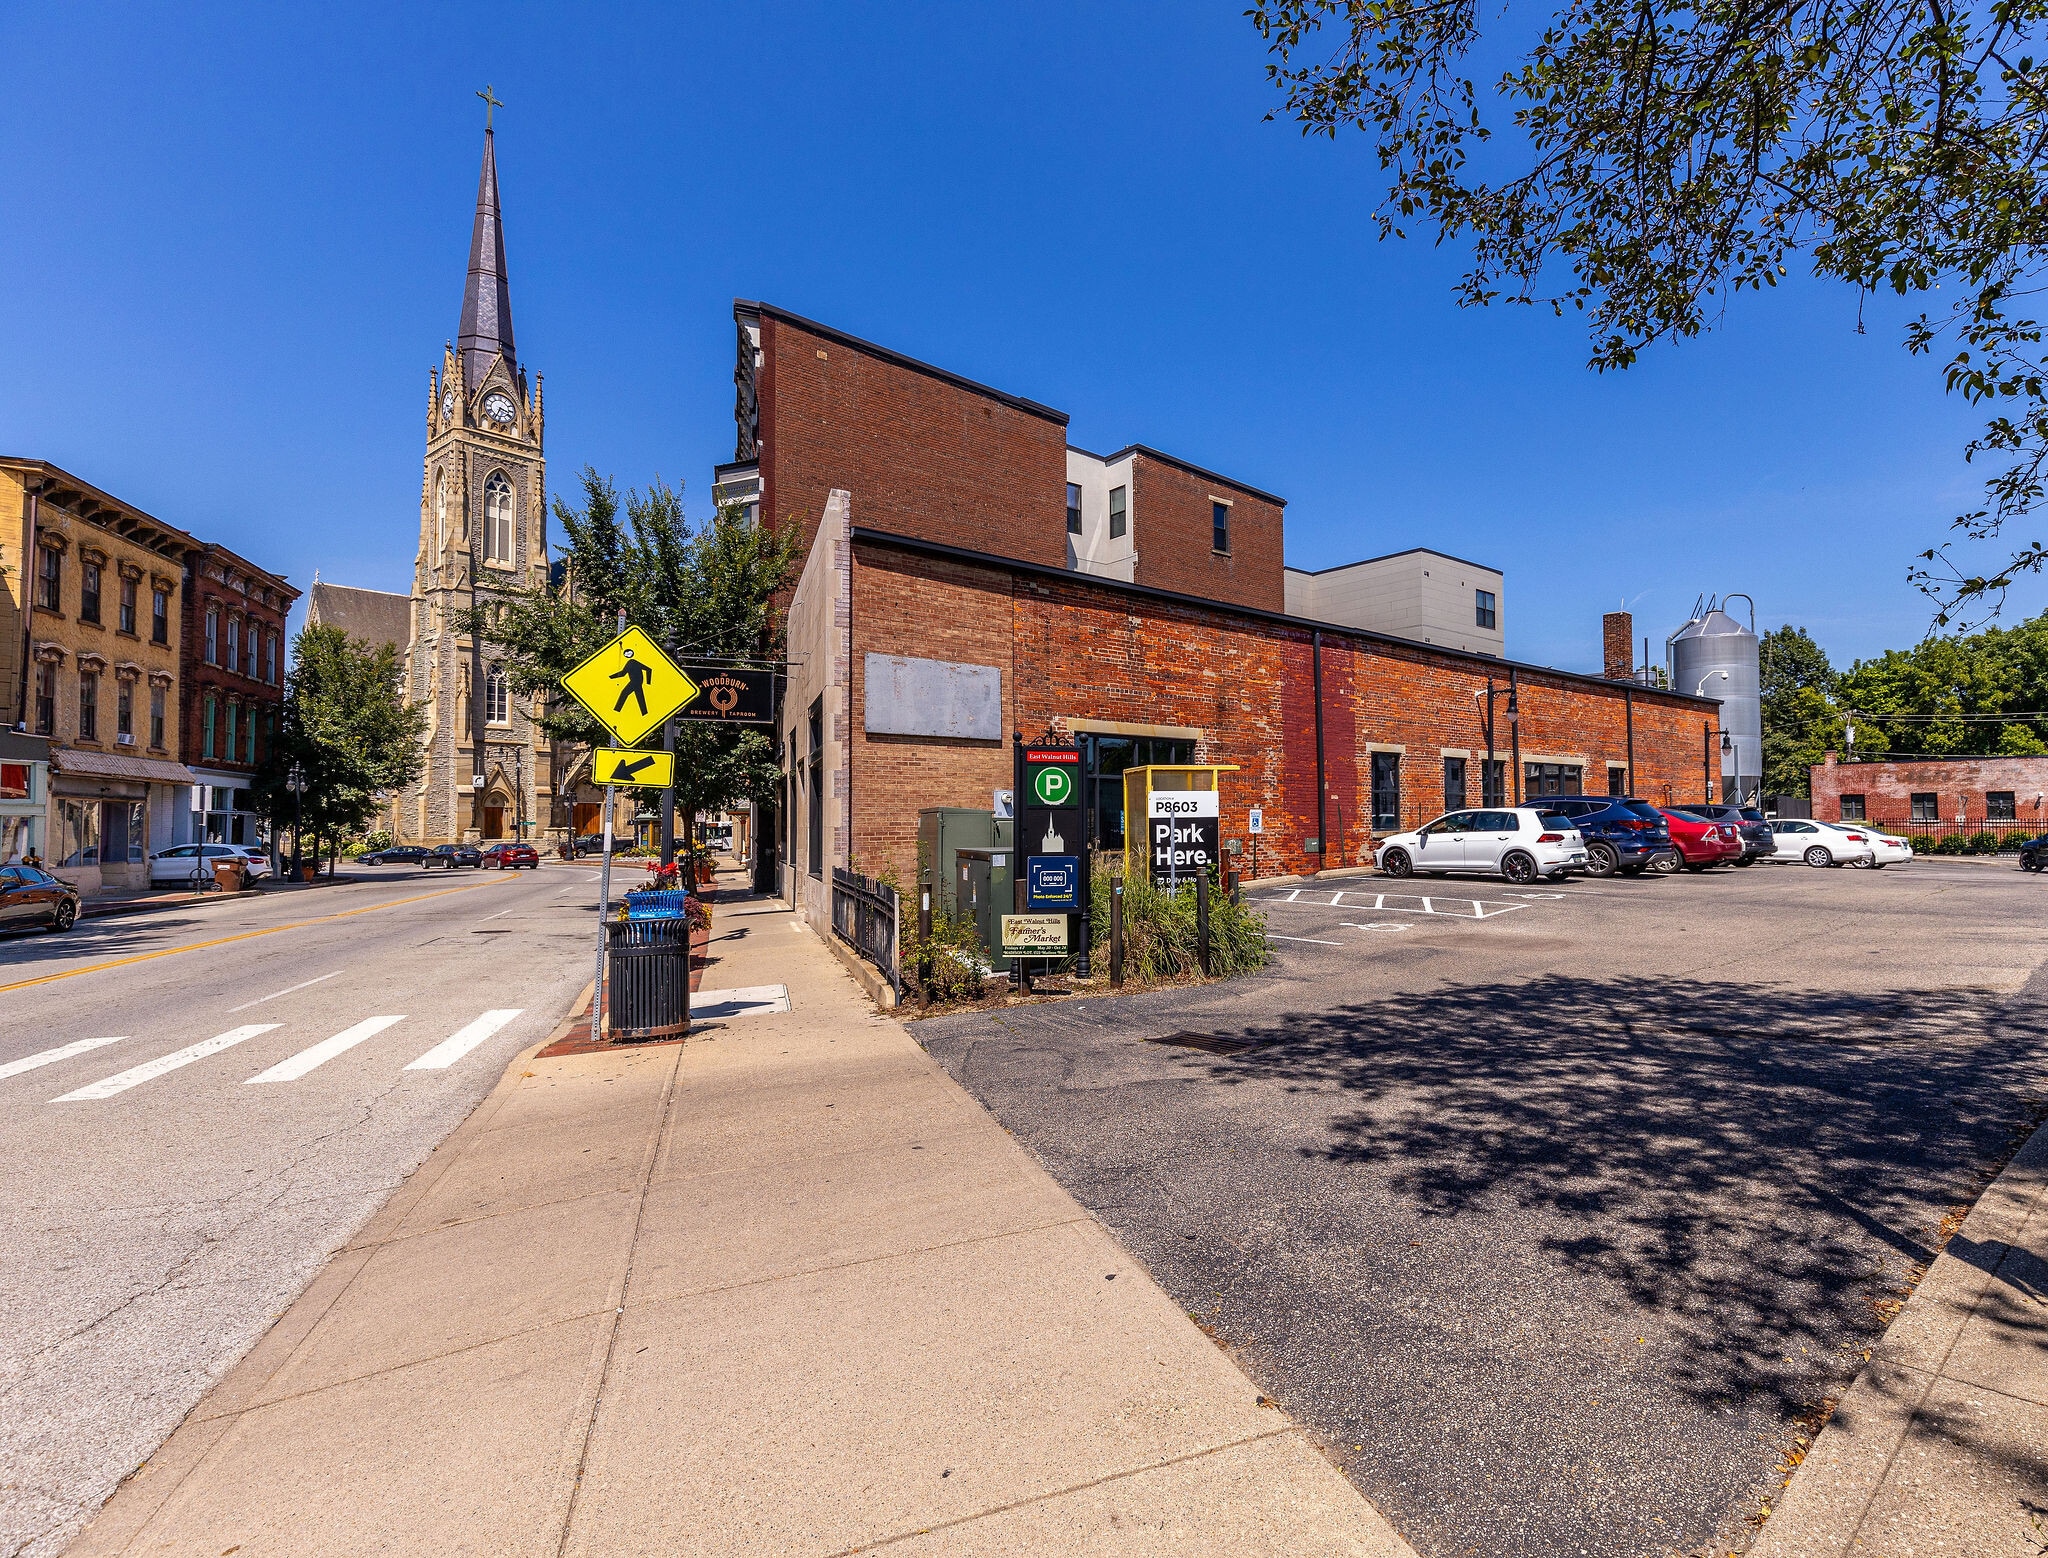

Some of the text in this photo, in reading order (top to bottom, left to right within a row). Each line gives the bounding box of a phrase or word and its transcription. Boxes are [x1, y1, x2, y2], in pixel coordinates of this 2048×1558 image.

[701, 677, 747, 691] WOODBURN
[1045, 774, 1063, 796] P
[1155, 801, 1198, 813] P8603
[1155, 823, 1205, 844] Park
[1156, 846, 1212, 866] Here.
[1008, 926, 1047, 935] Farmer's
[1023, 934, 1061, 943] Market
